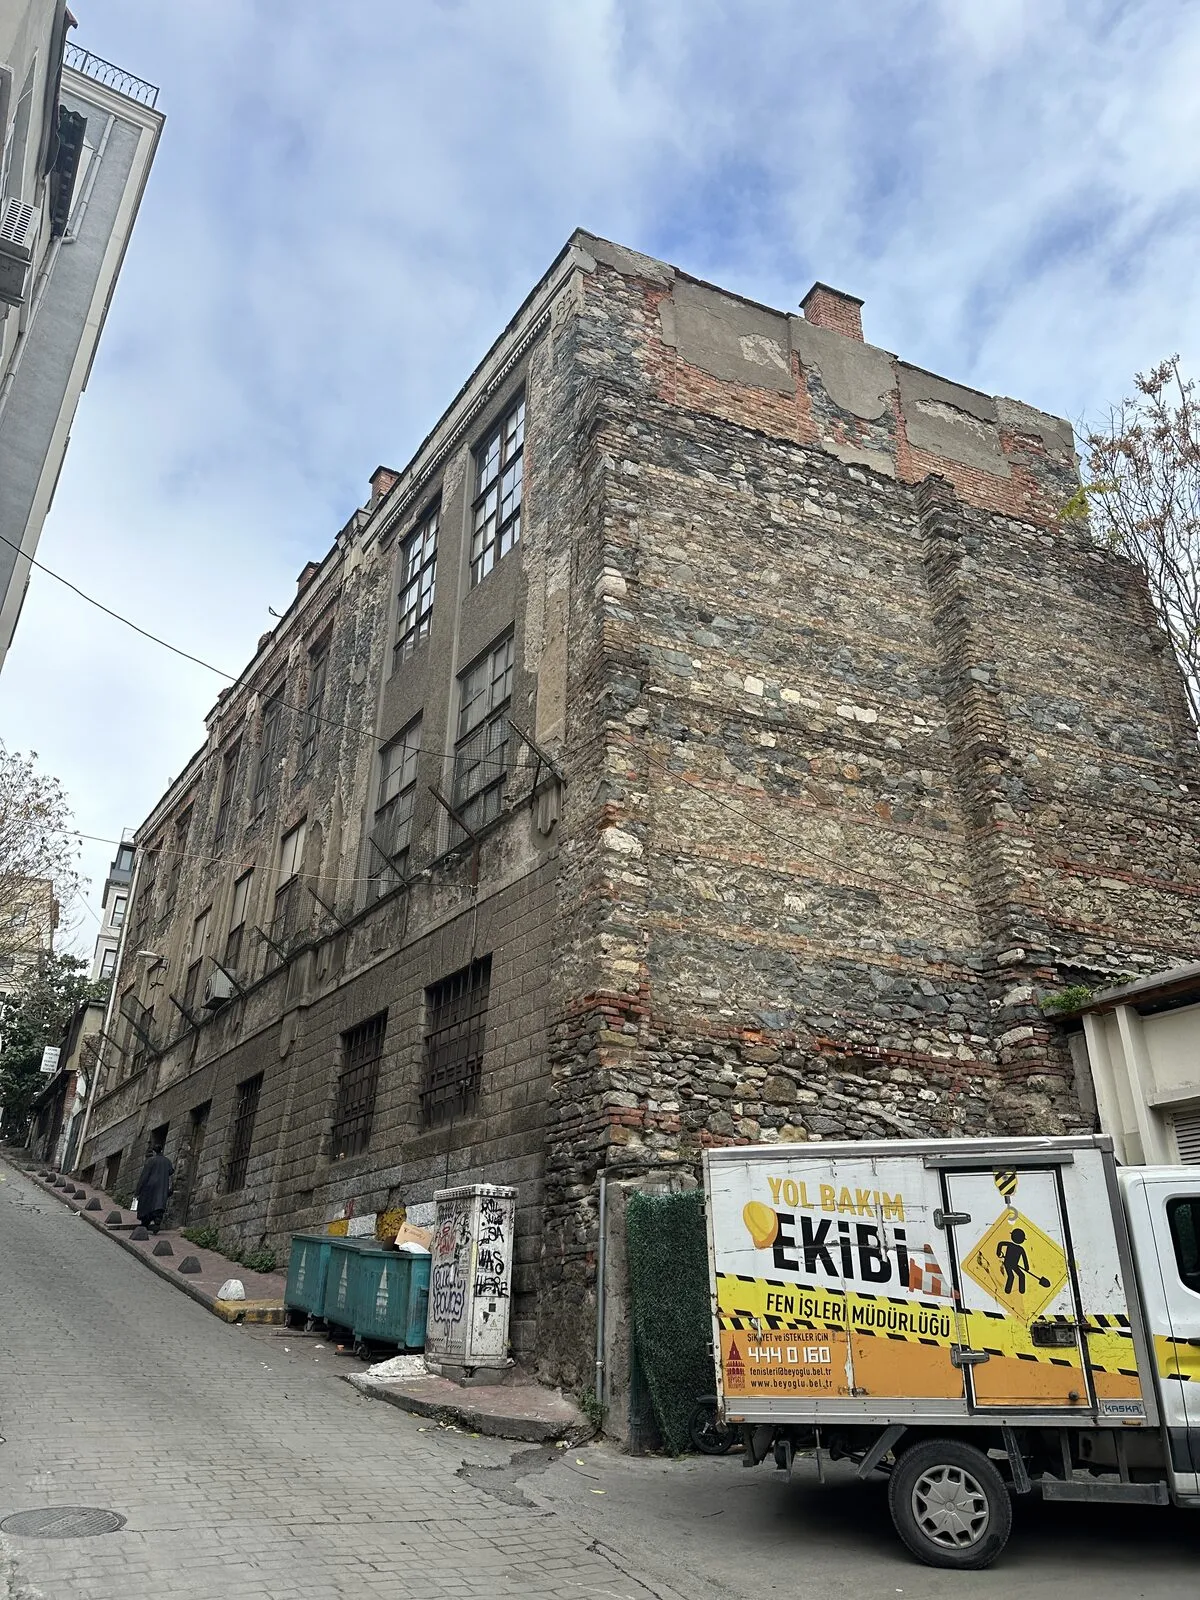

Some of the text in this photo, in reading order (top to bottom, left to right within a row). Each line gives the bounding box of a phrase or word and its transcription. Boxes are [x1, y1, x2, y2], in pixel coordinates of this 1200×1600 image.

[767, 1177, 905, 1222] YOL BAKIM
[479, 1249, 504, 1276] WAS
[766, 1293, 950, 1338] FEN İŞLERİ MÜDÜRLÜĞÜ
[774, 1334, 782, 1342] ve
[748, 1346, 831, 1363] 444 0 160
[750, 1367, 832, 1377] fenisleri@beyoglu.bel.tr
[750, 1379, 833, 1389] www.beyoglu.bel.tr
[1104, 1404, 1140, 1413] KASKA
